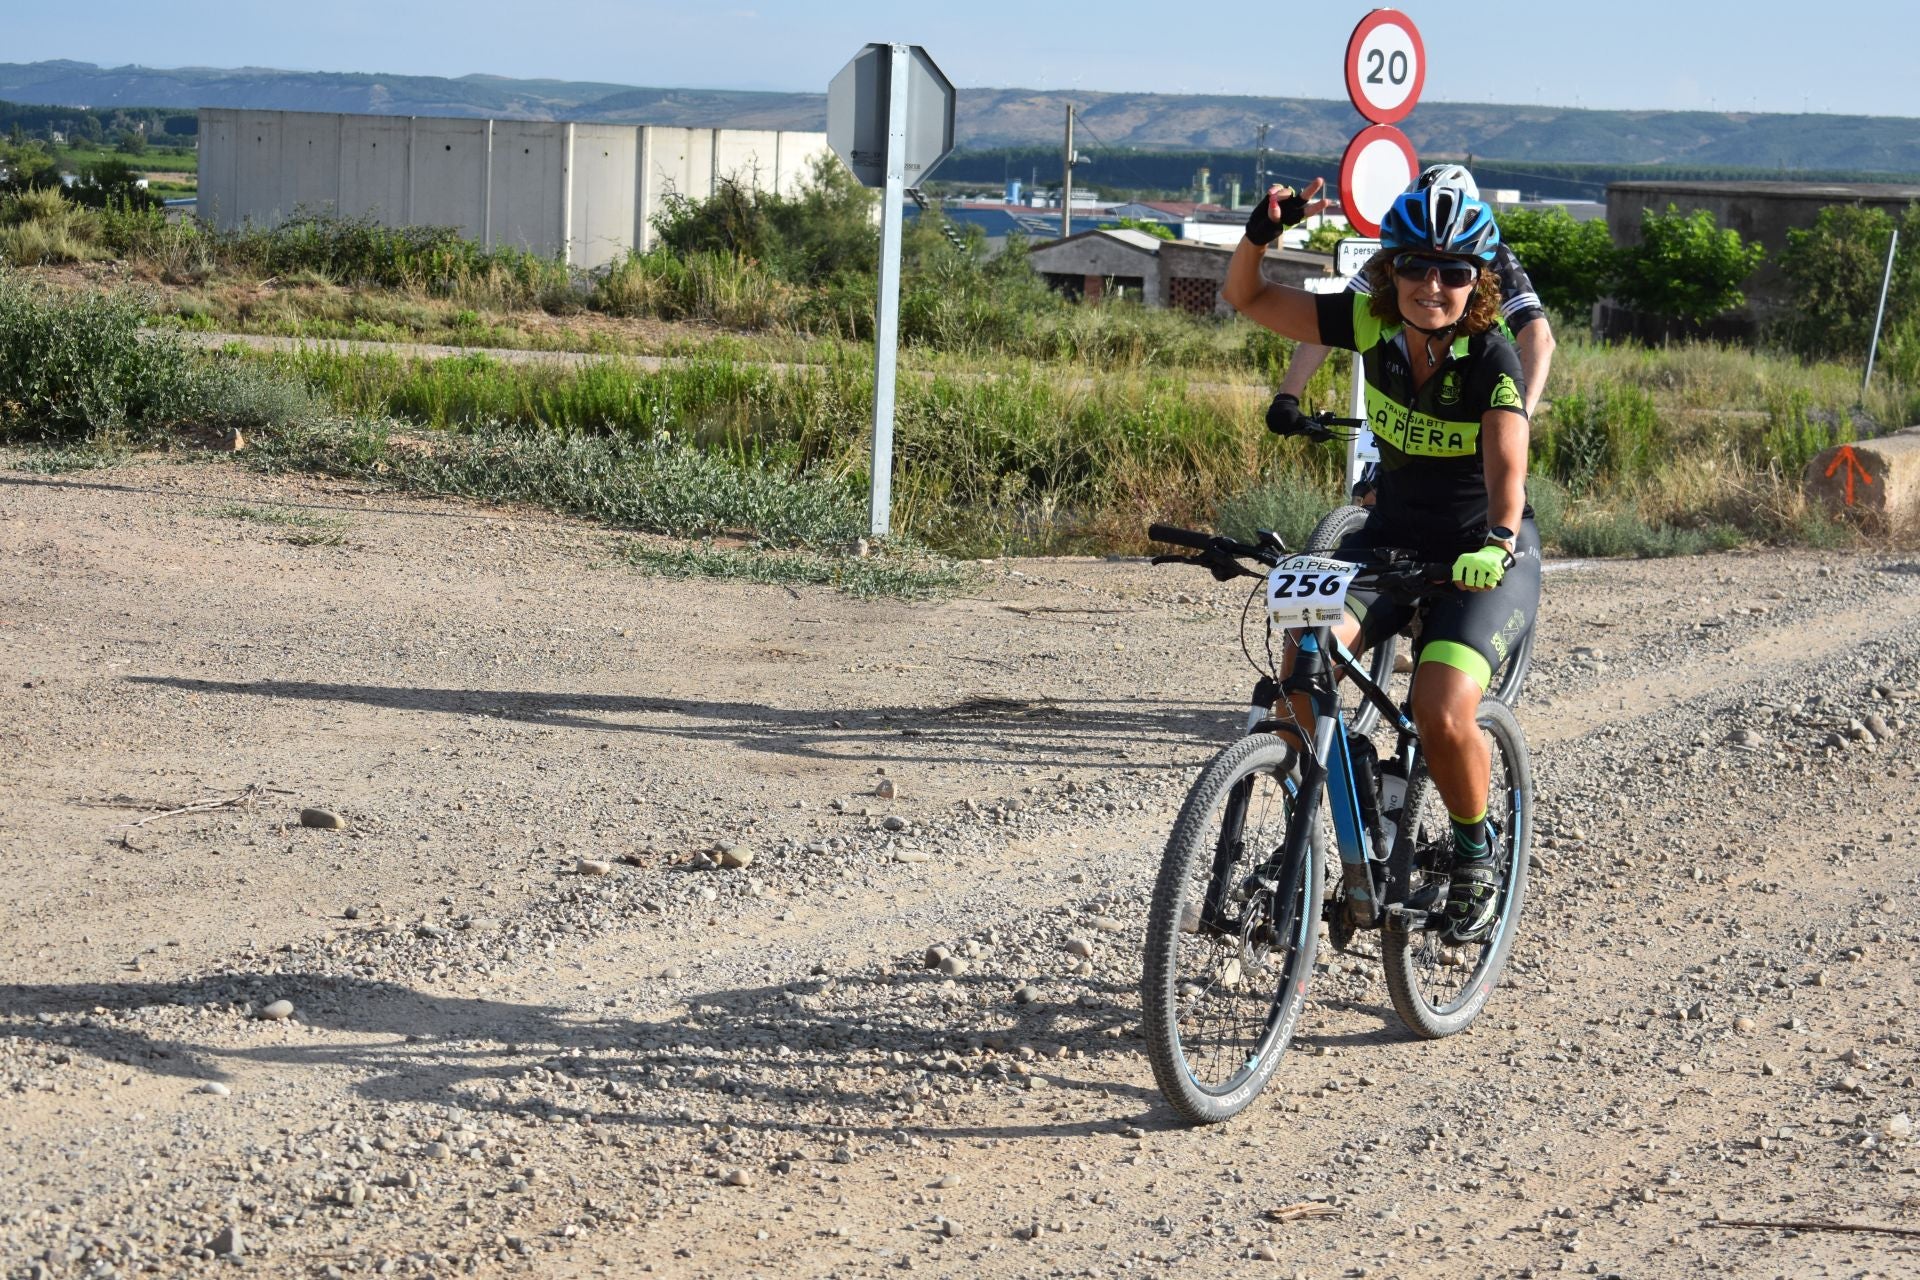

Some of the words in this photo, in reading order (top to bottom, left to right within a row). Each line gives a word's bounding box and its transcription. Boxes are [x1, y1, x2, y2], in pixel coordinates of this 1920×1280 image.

[1367, 49, 1407, 85] 20
[1343, 245, 1350, 255] A
[1354, 247, 1377, 256] perso
[1367, 399, 1388, 428] LA
[1393, 418, 1463, 449] PERA
[1384, 401, 1425, 425] TRAVESIA
[1426, 420, 1447, 430] BTT
[1282, 561, 1304, 571] LA
[1306, 561, 1351, 574] PERA
[1274, 574, 1341, 598] 256
[1259, 994, 1302, 1081] HUTCHINSON
